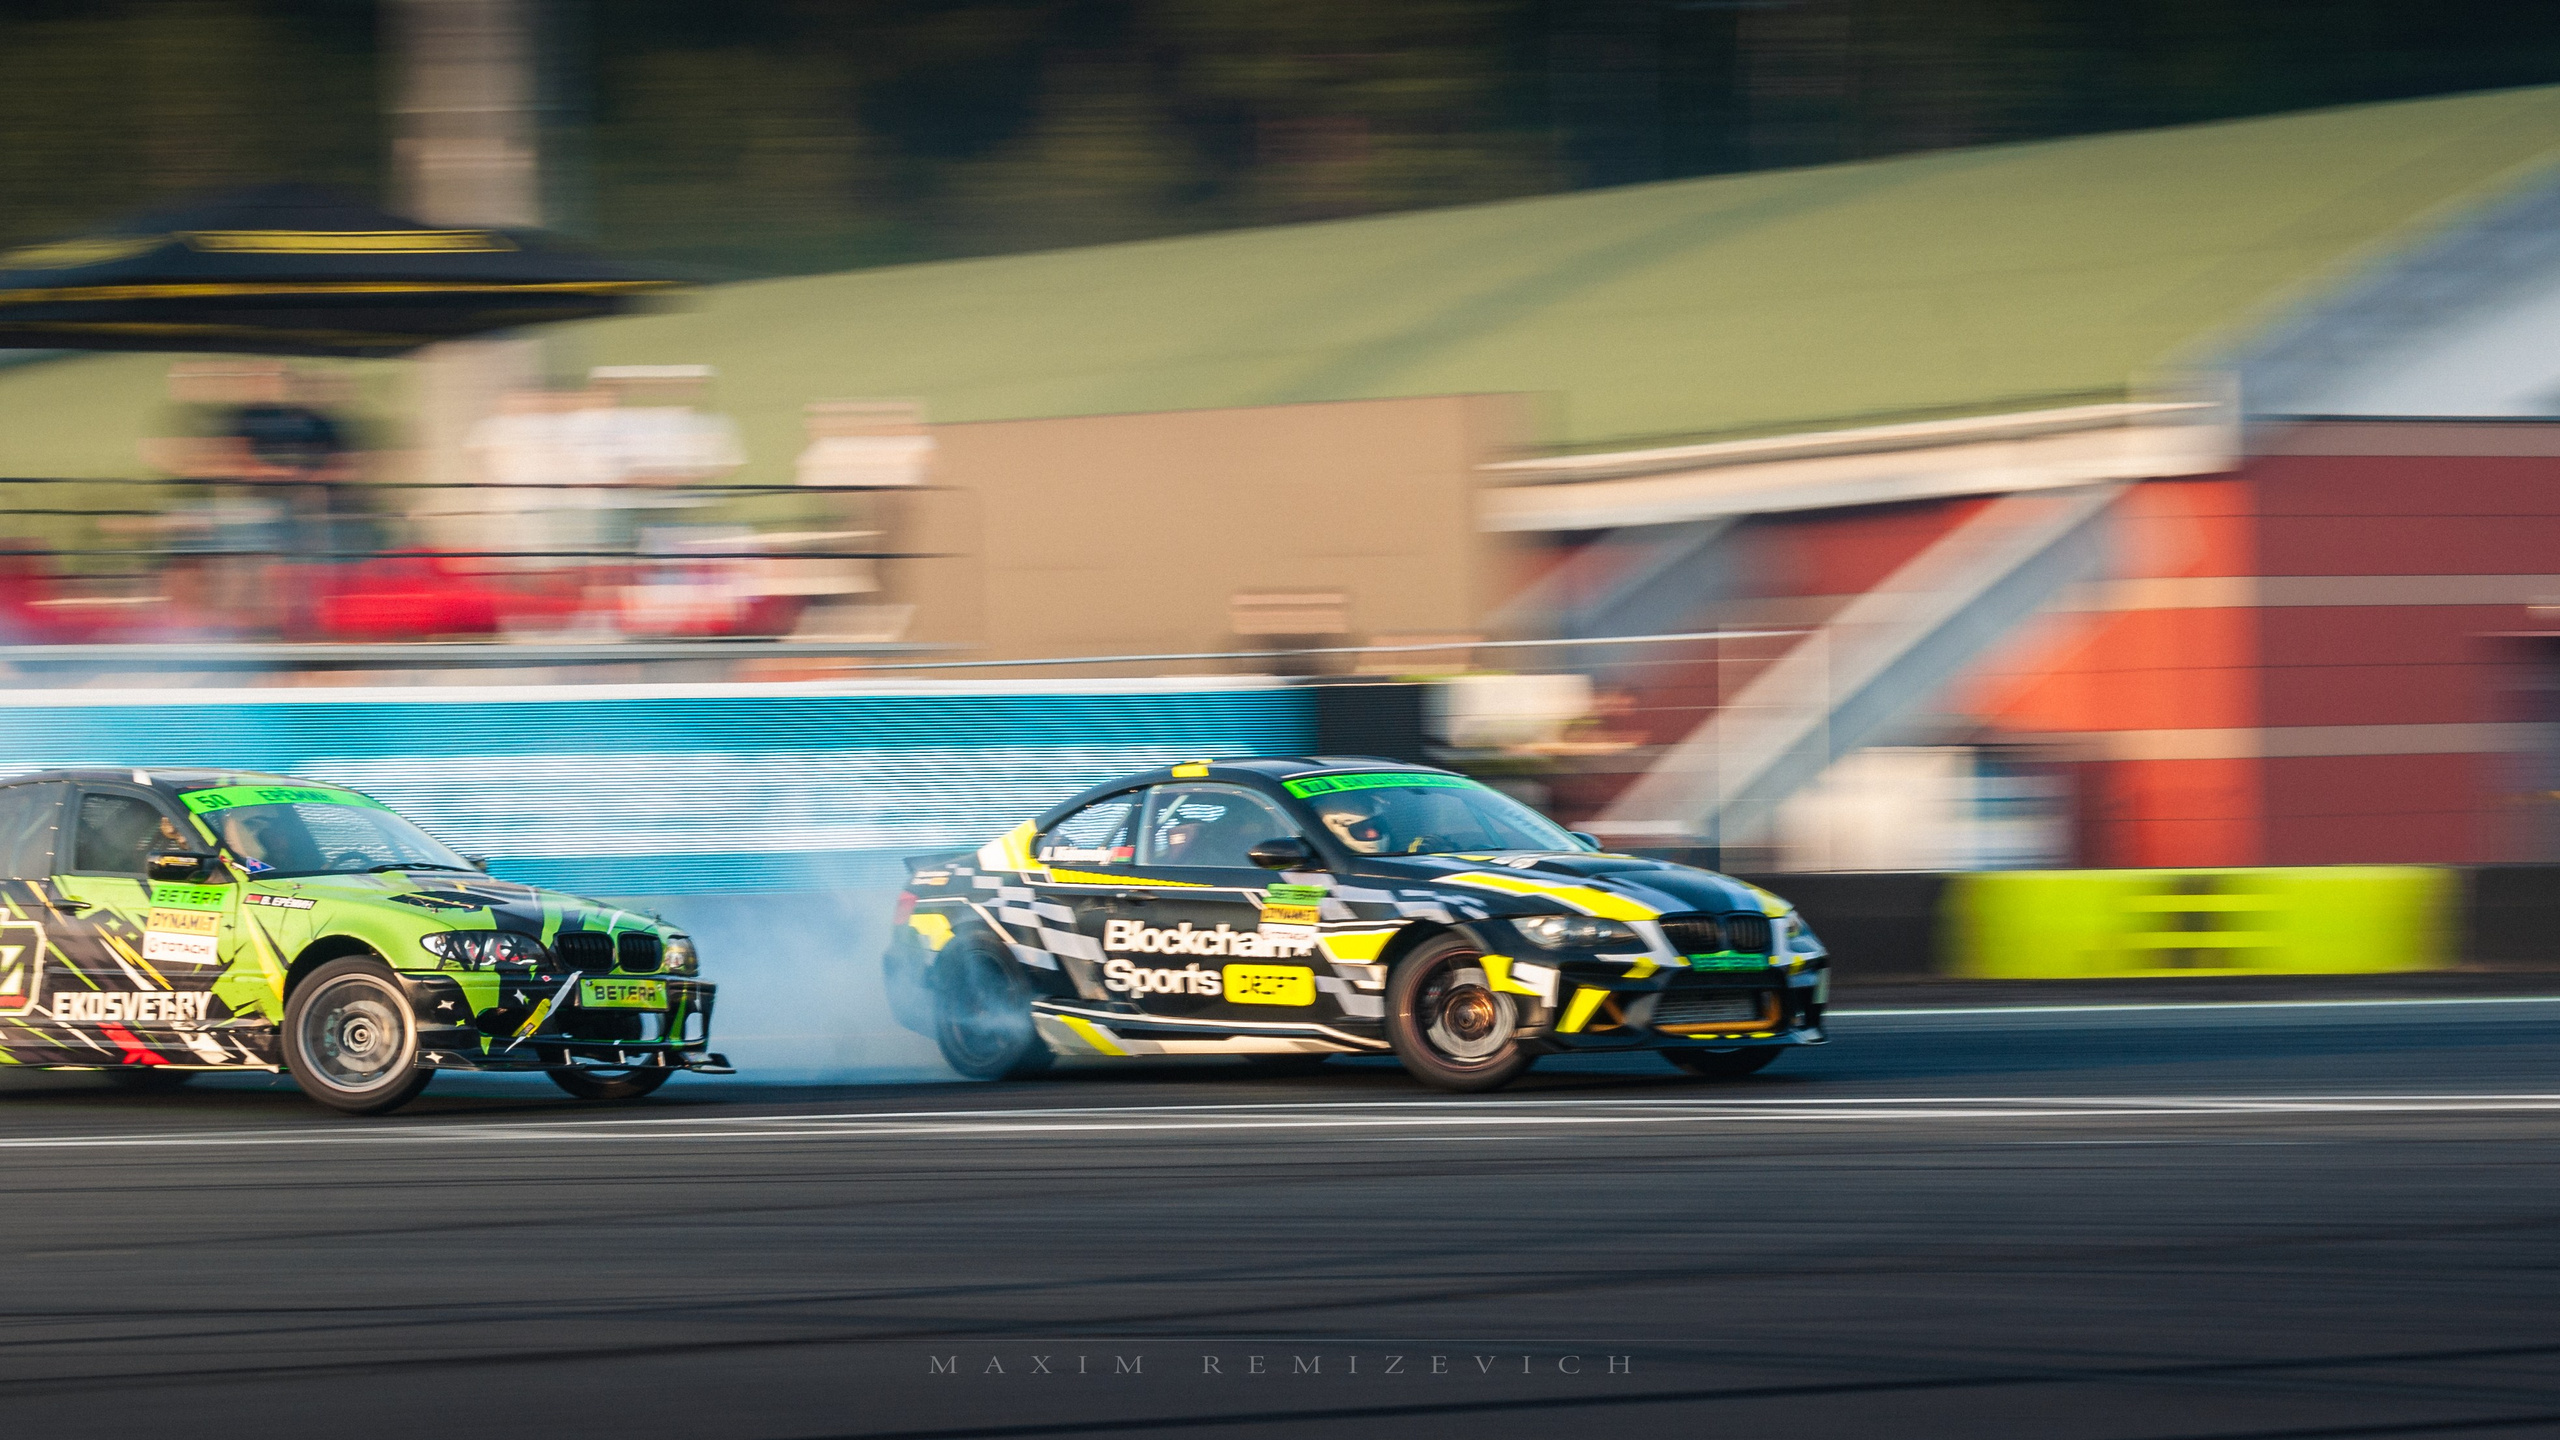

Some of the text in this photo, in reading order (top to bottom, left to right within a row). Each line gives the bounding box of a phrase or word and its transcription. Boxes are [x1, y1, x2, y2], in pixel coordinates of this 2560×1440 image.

[195, 794, 232, 809] 50
[157, 889, 222, 905] BETERA
[1103, 958, 1223, 998] Sports
[595, 985, 656, 1002] BETERA
